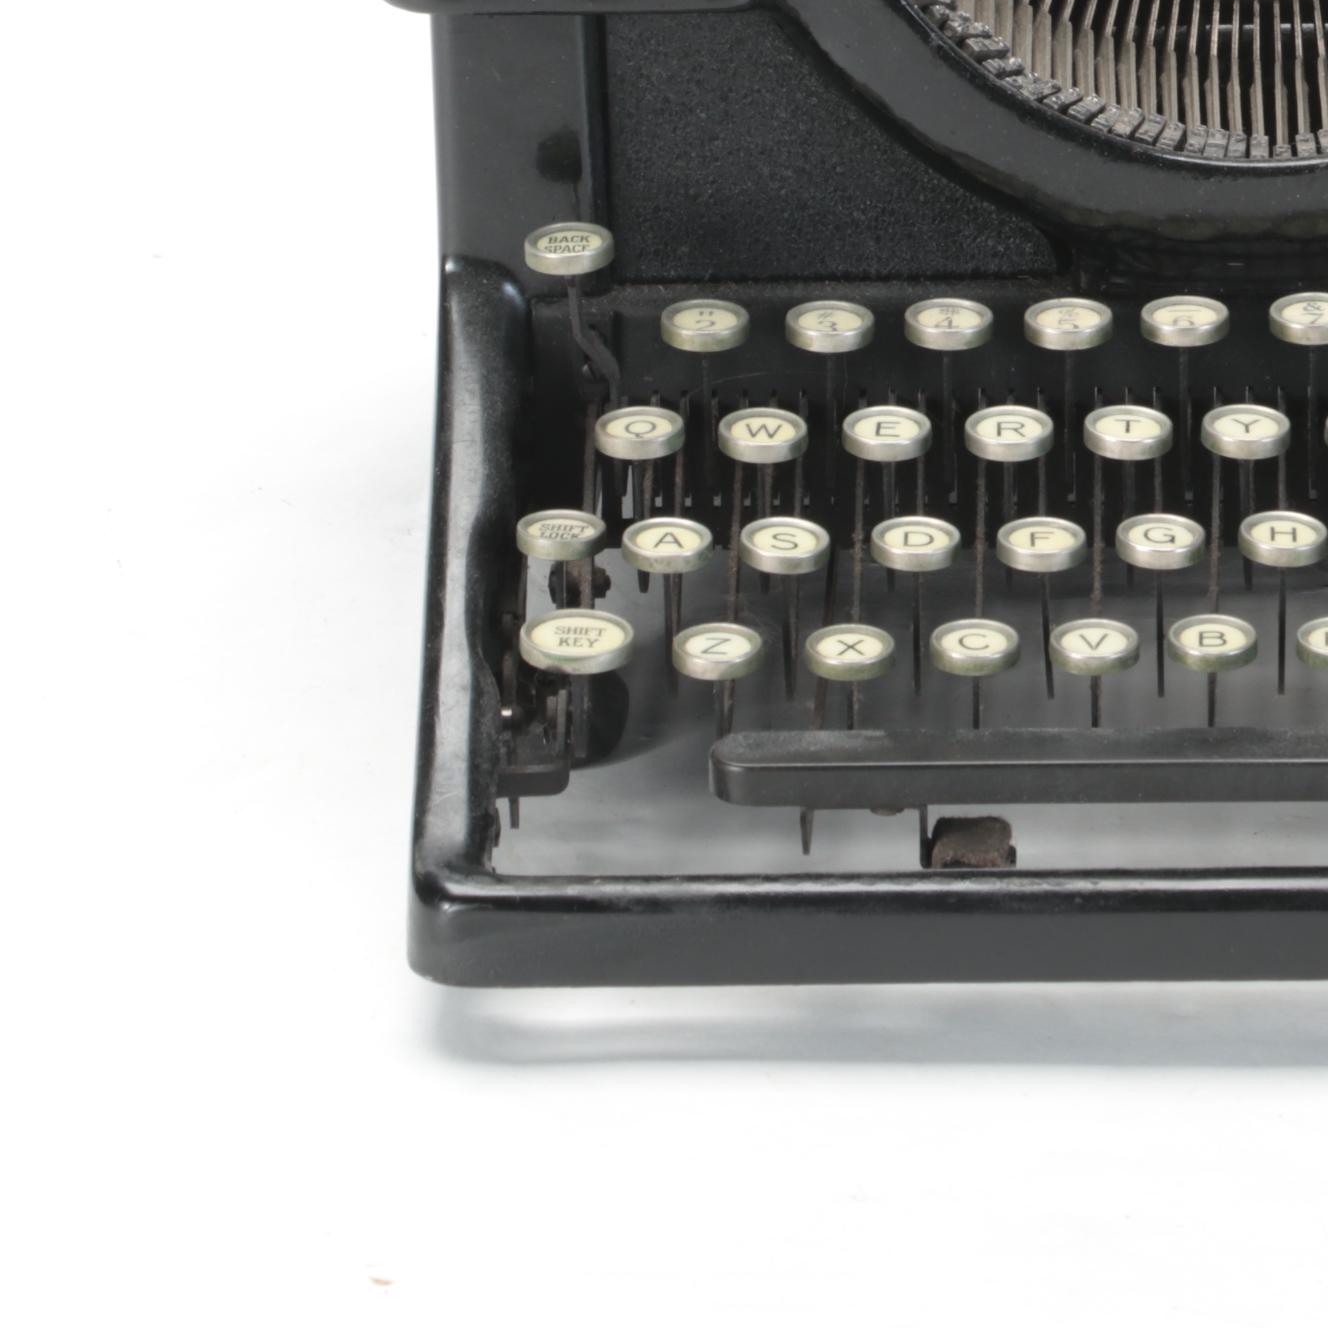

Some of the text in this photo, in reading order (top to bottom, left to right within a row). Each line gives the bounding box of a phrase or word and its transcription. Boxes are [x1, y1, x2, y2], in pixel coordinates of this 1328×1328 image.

[547, 234, 591, 245] BACK
[544, 244, 591, 254] SPACE
[934, 316, 960, 330] 4
[1303, 312, 1324, 325] 7
[624, 419, 657, 439] Q
[745, 423, 783, 440] W
[875, 421, 901, 438] E
[996, 421, 1027, 438] R
[1114, 418, 1142, 434] T
[1233, 418, 1261, 434] Y
[538, 522, 590, 533] SHIFT
[539, 530, 582, 541] LOCK
[1142, 525, 1176, 545] G
[1269, 525, 1298, 543] H
[653, 532, 685, 549] A
[771, 532, 799, 551] S
[903, 530, 935, 548] D
[1030, 530, 1055, 548] F
[554, 625, 607, 637] SHIFT
[1198, 631, 1228, 648] B
[558, 636, 601, 650] KEY
[700, 636, 733, 655] Z
[835, 639, 866, 657] X
[958, 633, 991, 651] C
[1078, 633, 1109, 651] V
